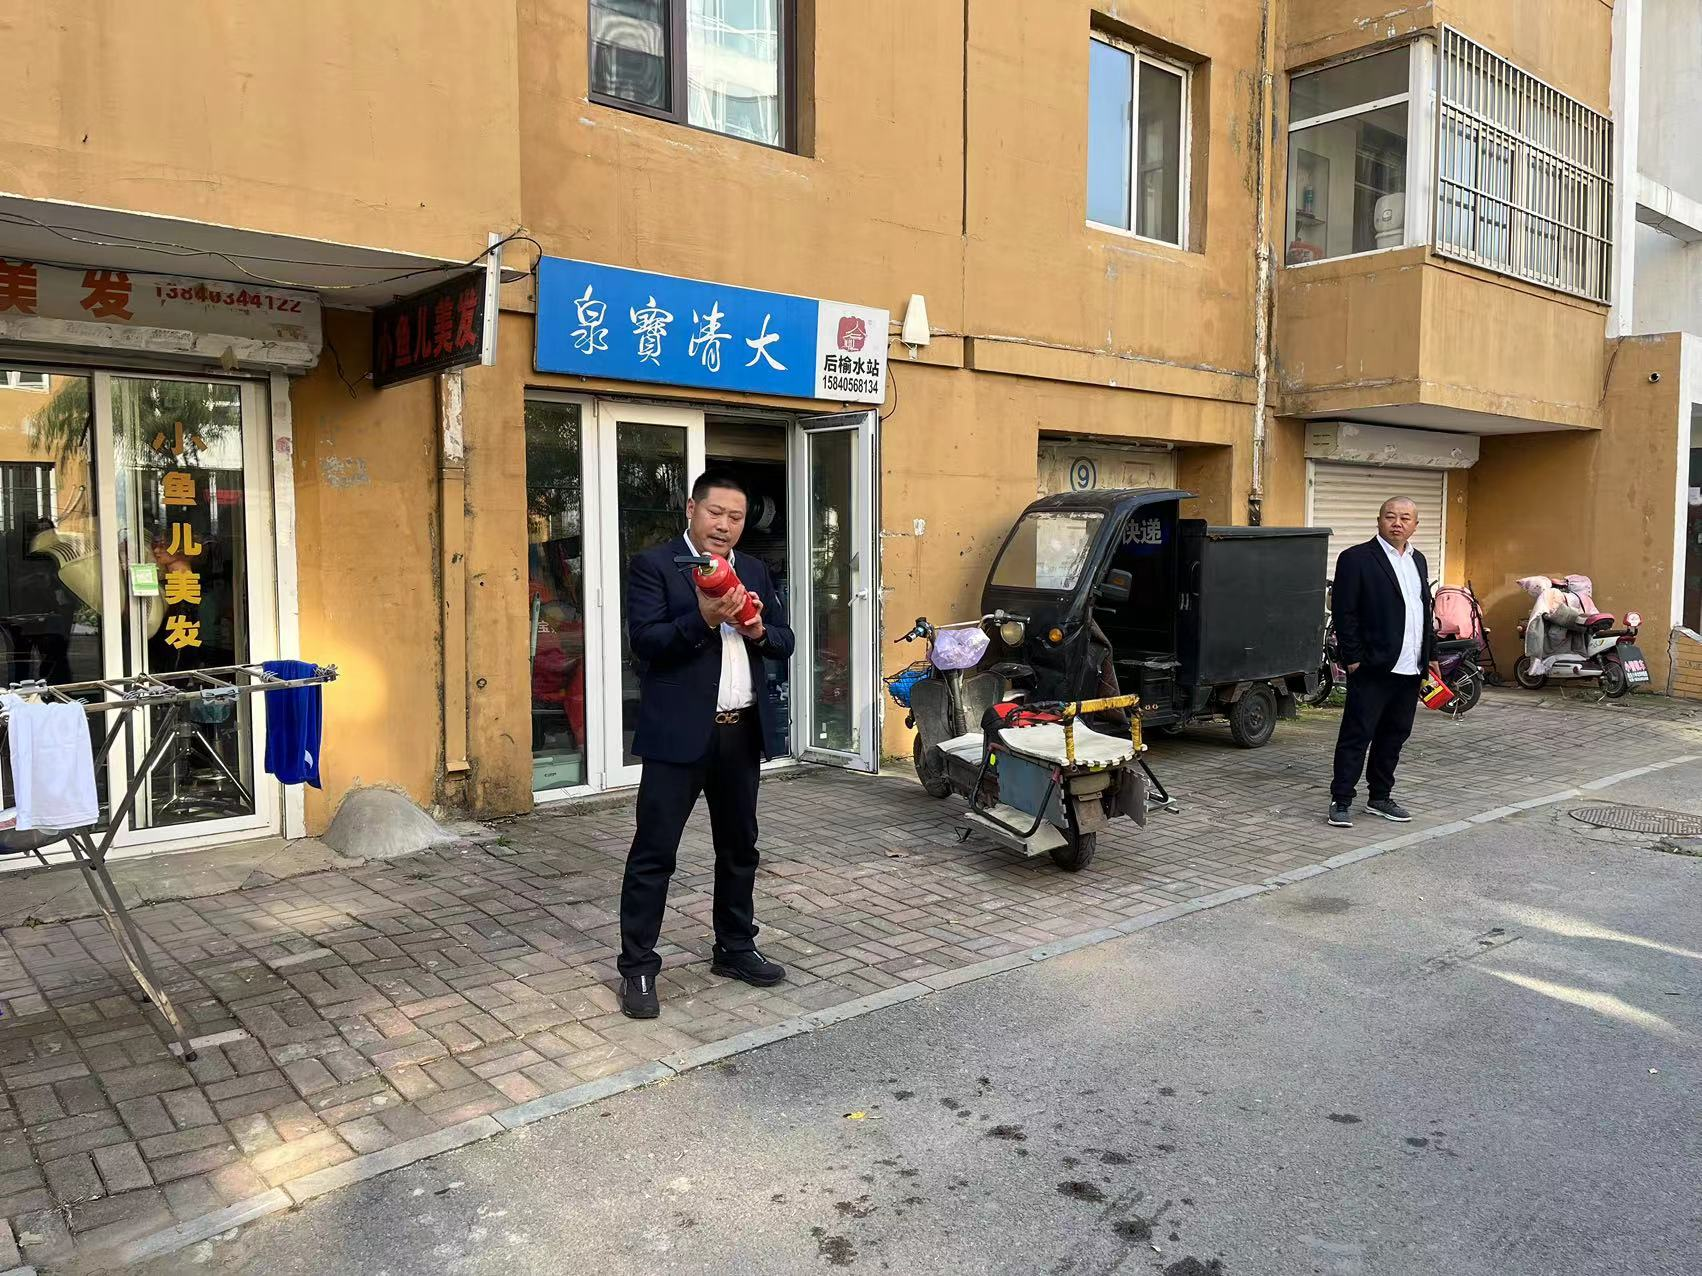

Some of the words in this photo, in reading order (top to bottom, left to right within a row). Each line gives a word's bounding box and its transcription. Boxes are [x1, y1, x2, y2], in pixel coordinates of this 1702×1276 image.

[823, 354, 880, 378] 后榆水站
[822, 374, 879, 394] 15840568134
[152, 421, 208, 650] 小鱼儿美发
